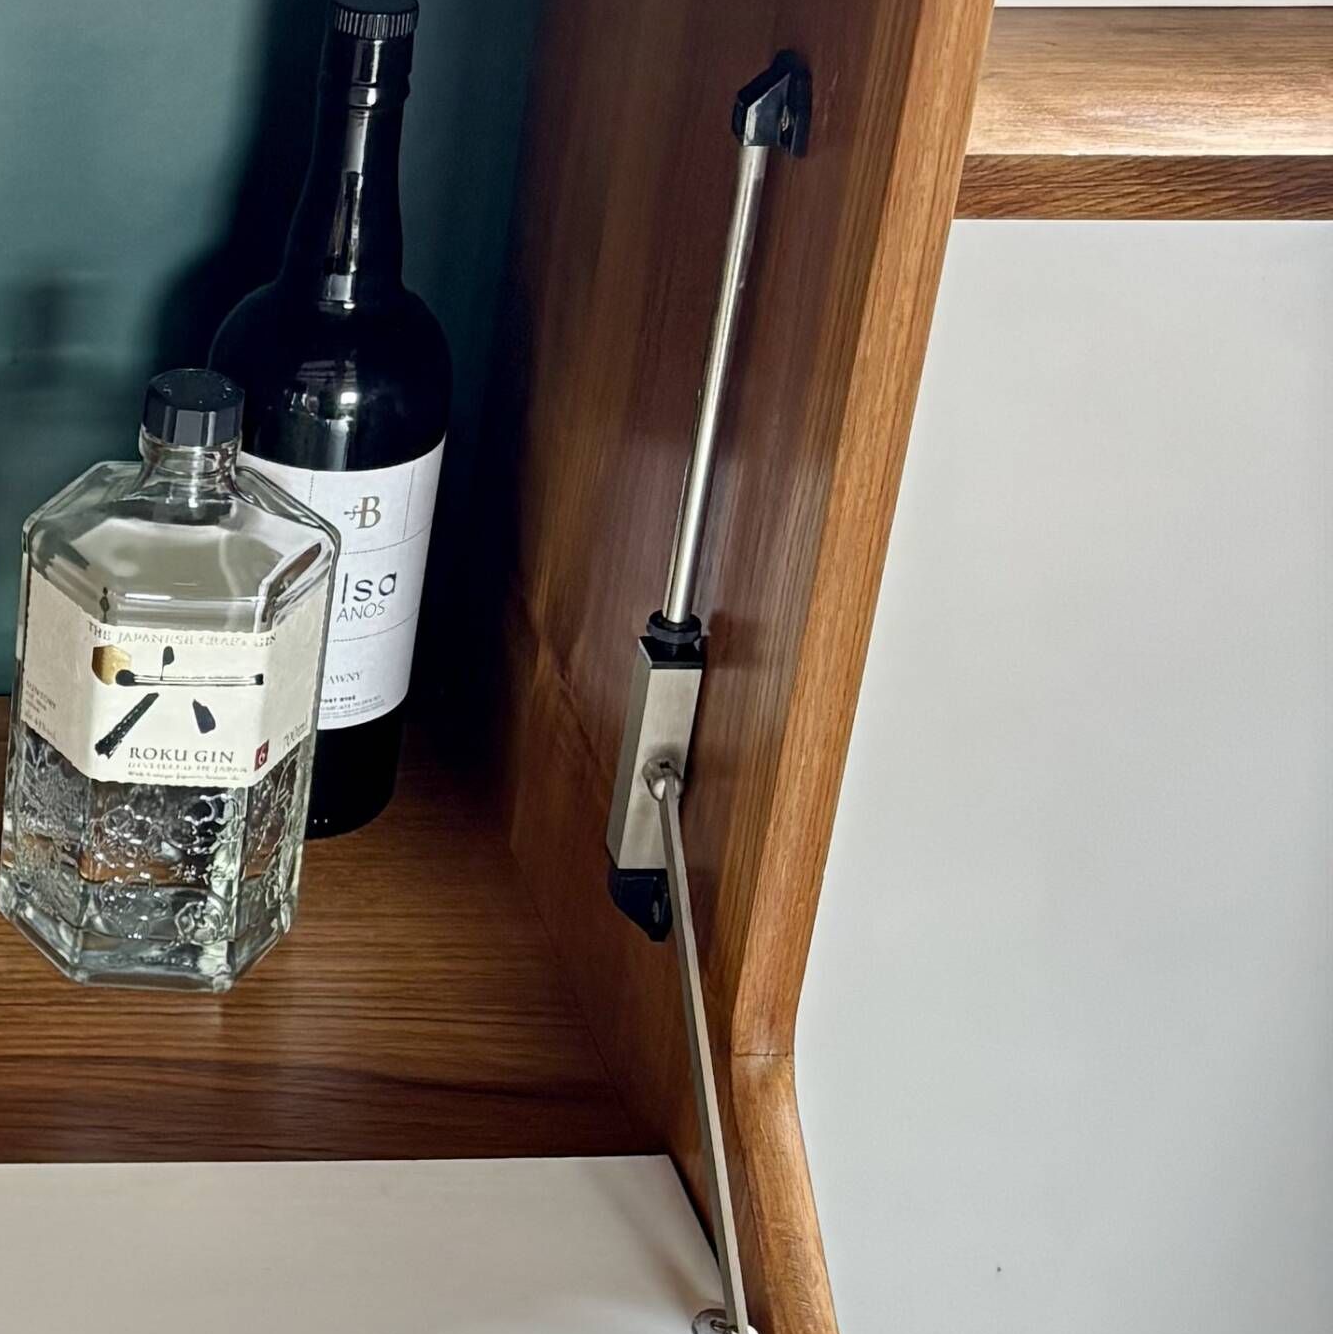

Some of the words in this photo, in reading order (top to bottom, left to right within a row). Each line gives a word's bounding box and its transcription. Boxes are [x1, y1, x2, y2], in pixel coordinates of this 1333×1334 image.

[336, 599, 386, 623] ANOS
[88, 621, 112, 642] THE
[326, 670, 363, 685] AWNY
[129, 747, 188, 763] ROKU
[194, 750, 235, 764] GIN
